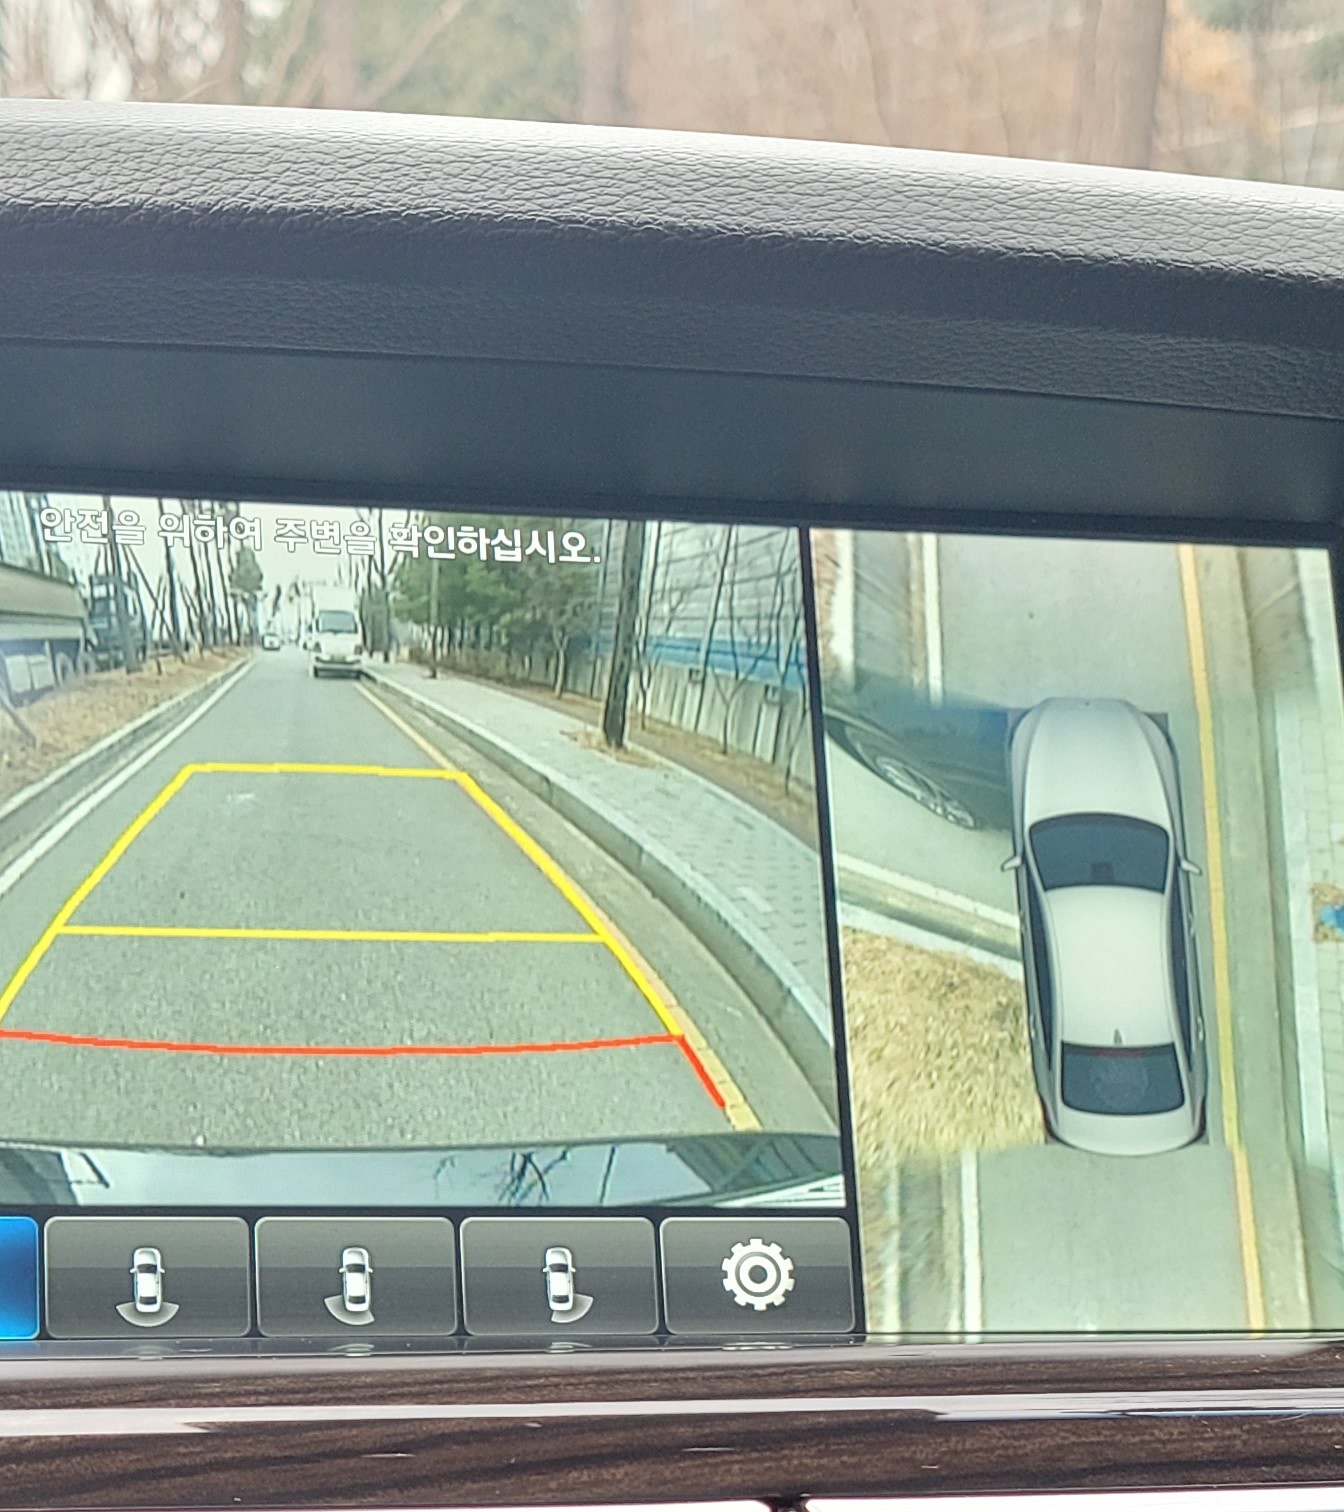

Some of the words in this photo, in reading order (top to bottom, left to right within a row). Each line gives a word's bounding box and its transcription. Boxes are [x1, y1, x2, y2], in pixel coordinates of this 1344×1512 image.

[39, 507, 147, 546] 안전을
[158, 514, 263, 551] 위하여
[273, 520, 380, 556] 주변을
[388, 524, 602, 565] 확인하십시오.
